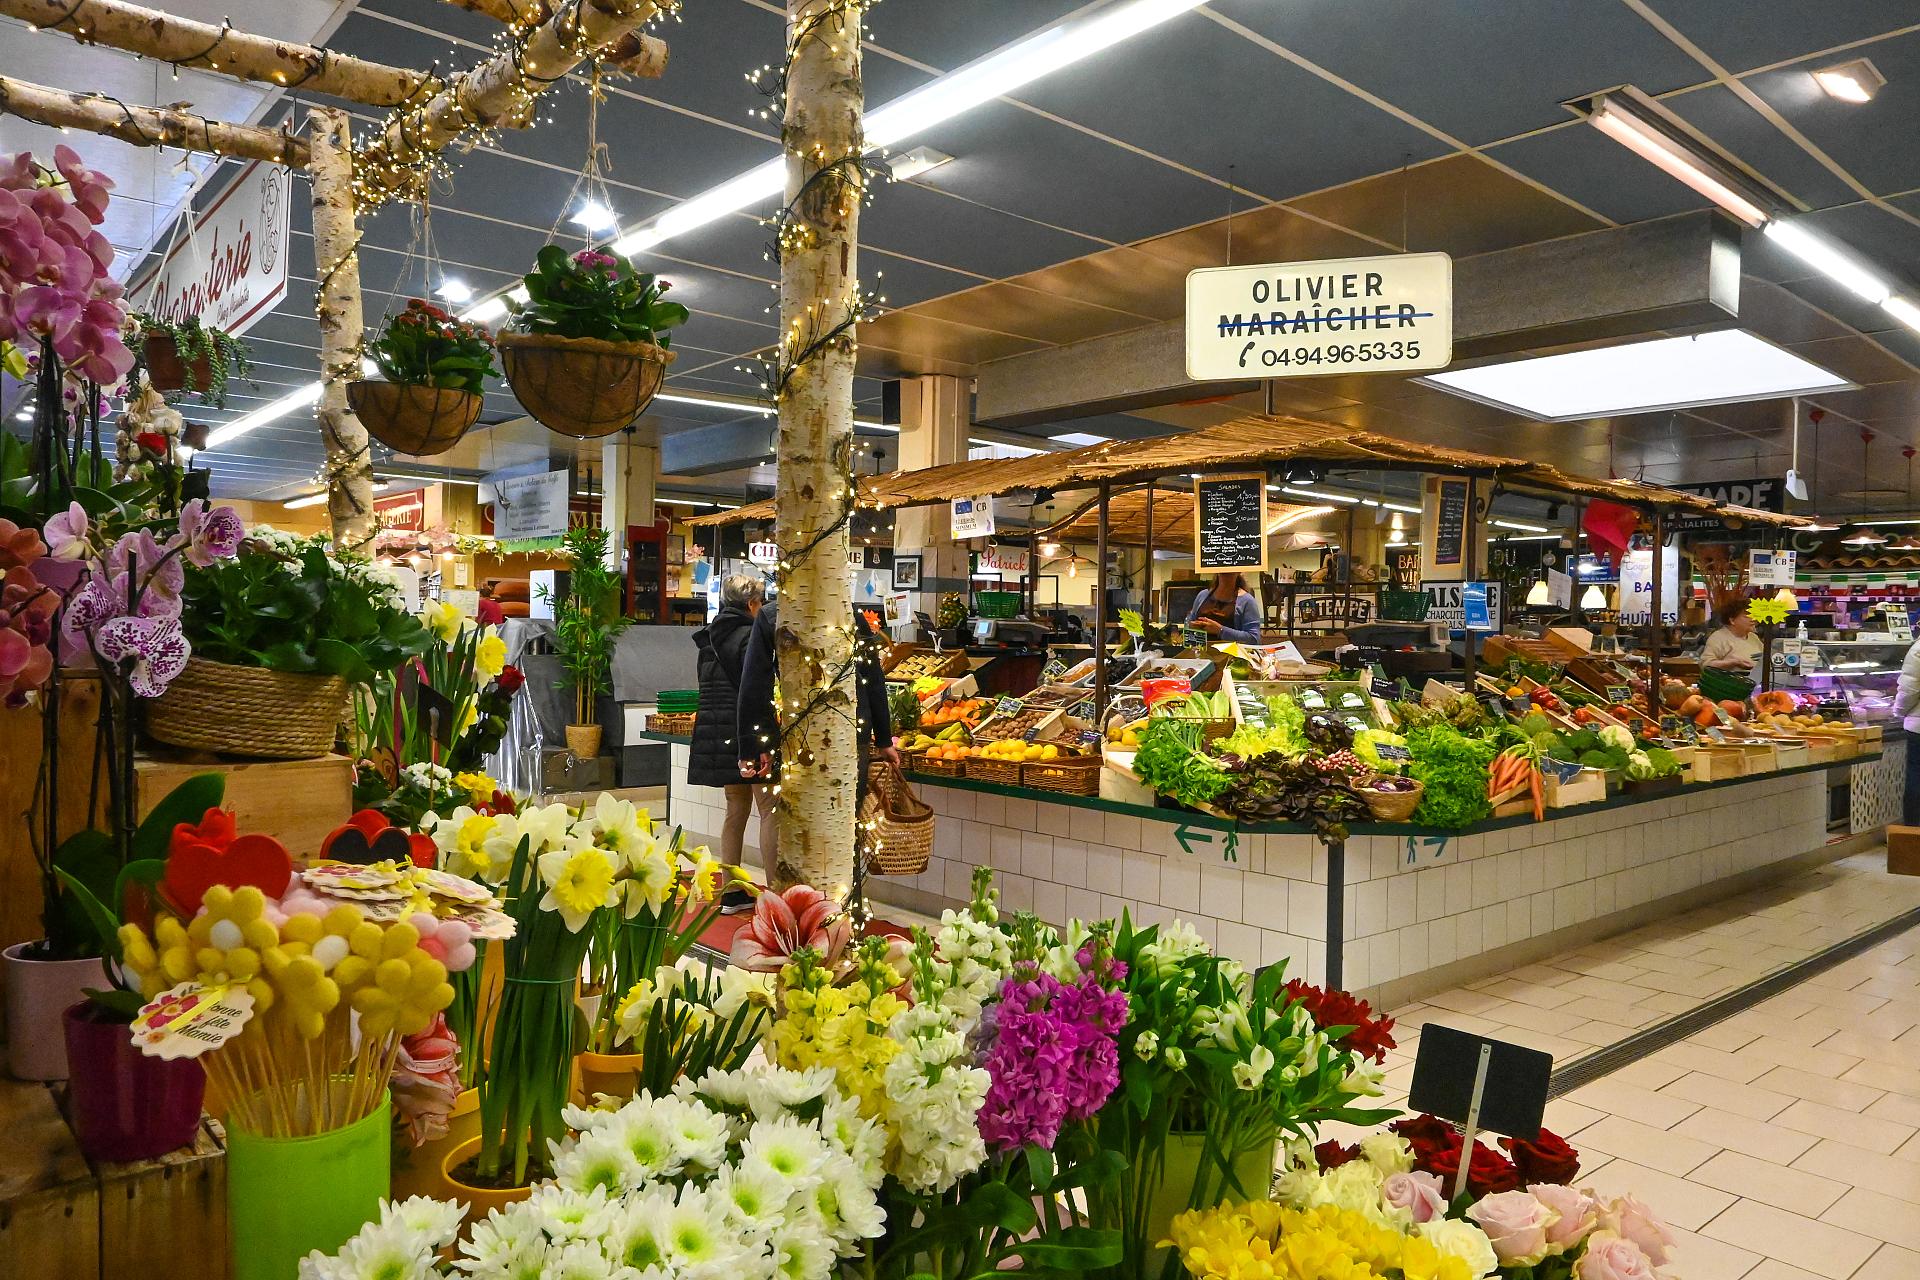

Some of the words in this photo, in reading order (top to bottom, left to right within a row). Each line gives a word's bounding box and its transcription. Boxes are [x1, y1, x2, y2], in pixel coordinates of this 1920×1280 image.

[1252, 272, 1383, 304] OLIVIER
[1219, 302, 1416, 337] MARAÎCHER
[1261, 341, 1421, 367] 04-94-96-53-35
[976, 502, 987, 512] CB
[981, 546, 1028, 571] Patrick
[1775, 558, 1787, 566] CB
[1428, 586, 1498, 608] ALSE
[1634, 581, 1662, 593] BA
[1621, 610, 1677, 625] HUÎTES
[200, 1015, 231, 1030] fête
[174, 1024, 223, 1044] Mamie
